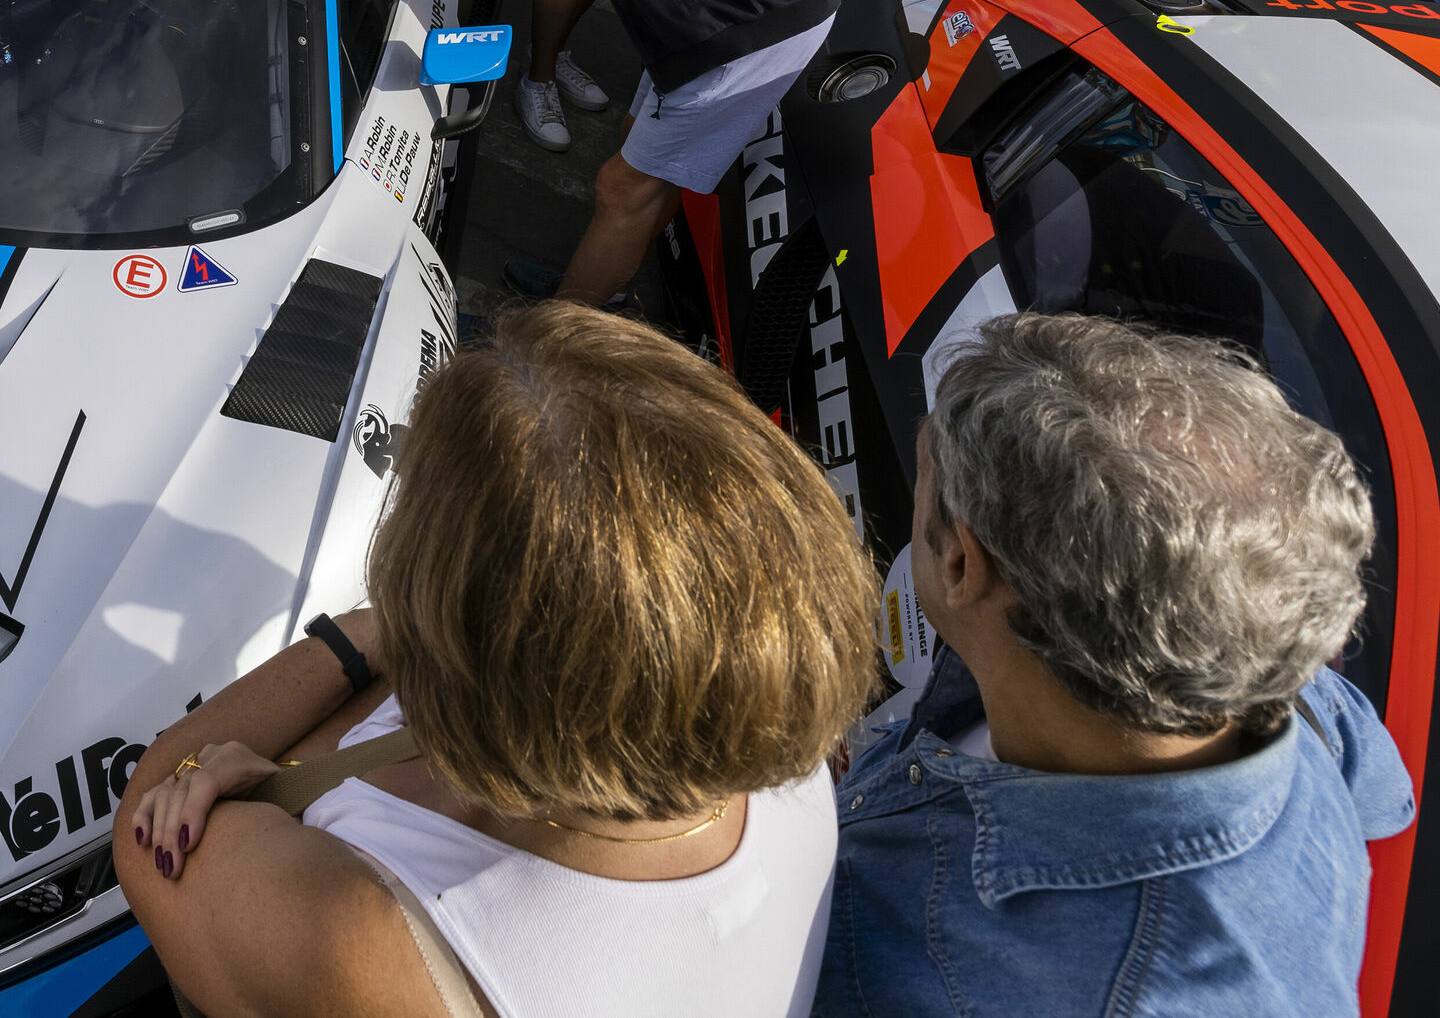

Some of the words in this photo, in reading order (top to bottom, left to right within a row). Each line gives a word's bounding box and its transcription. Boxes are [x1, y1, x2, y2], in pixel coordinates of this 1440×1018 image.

[437, 31, 504, 45] WRT
[989, 34, 1022, 71] WRT
[126, 260, 154, 289] E
[904, 593, 912, 630] POWERED
[909, 633, 914, 642] BY
